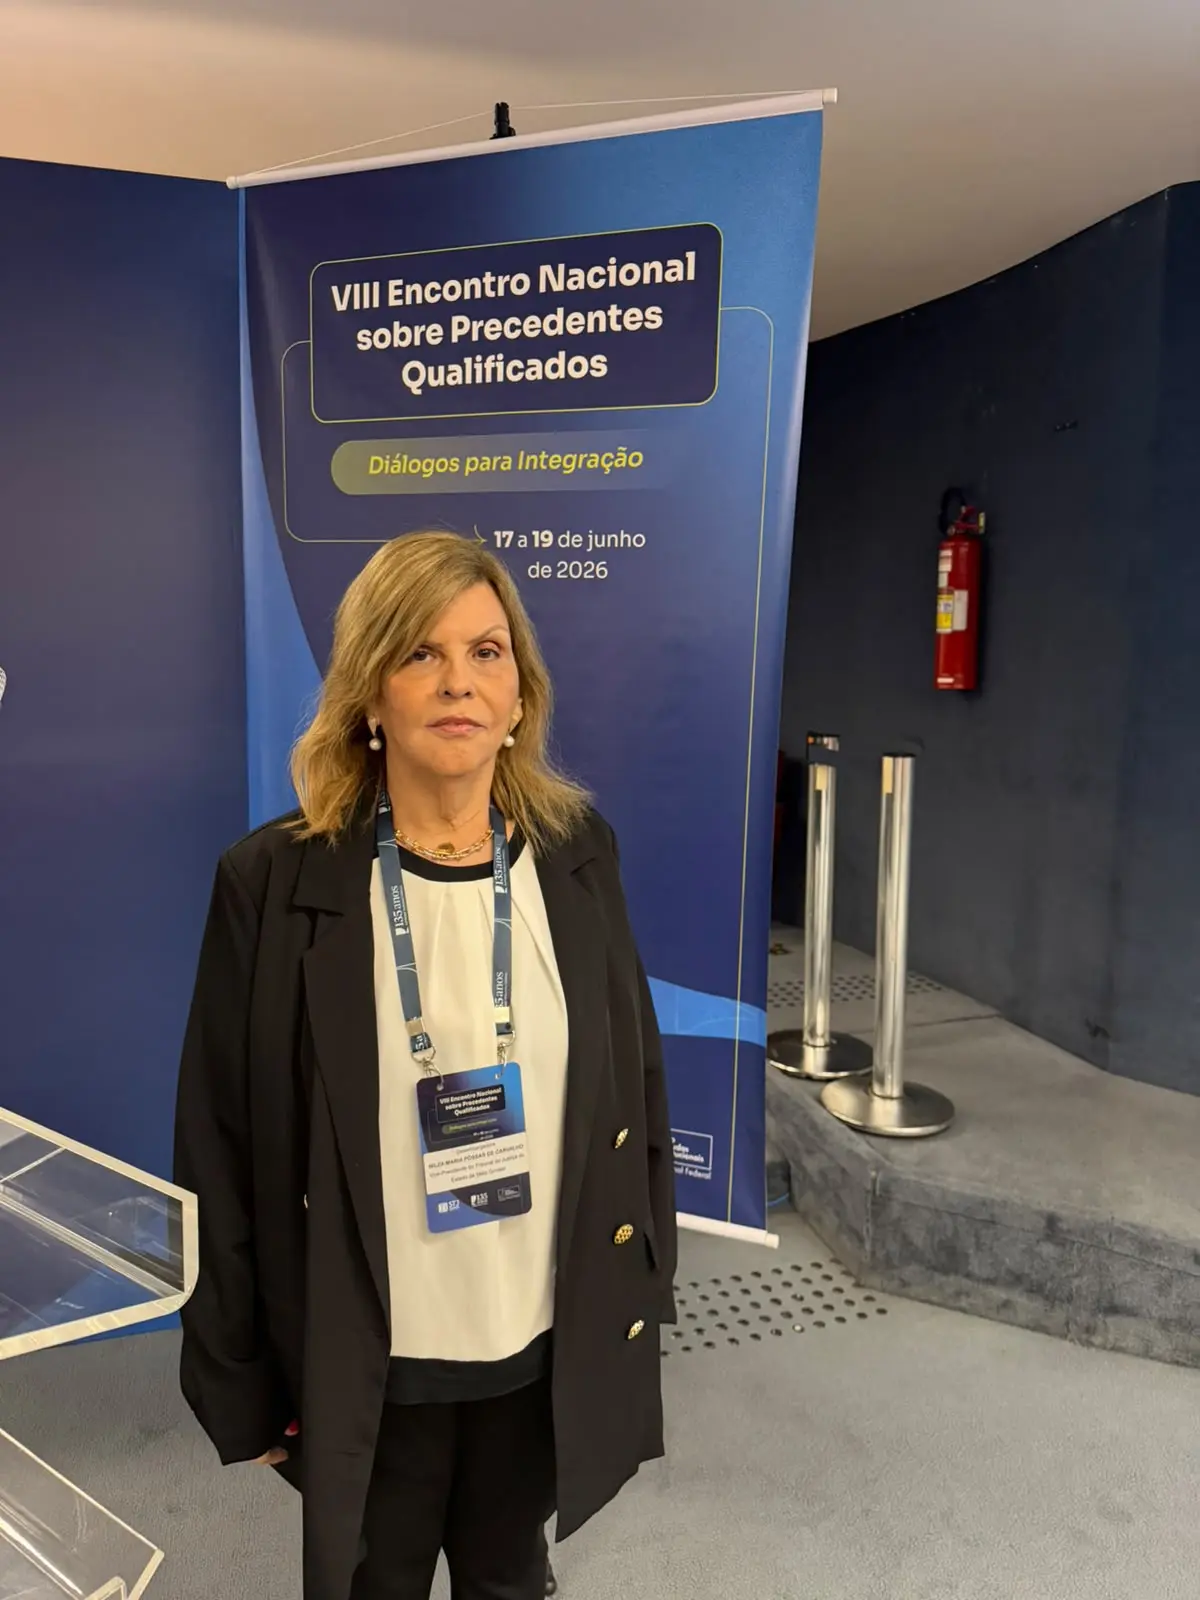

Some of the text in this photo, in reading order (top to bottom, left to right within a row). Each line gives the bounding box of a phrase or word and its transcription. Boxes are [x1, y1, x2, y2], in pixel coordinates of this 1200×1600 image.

[331, 251, 696, 311] VIII Encontro Nacional
[356, 305, 663, 351] sobre Precedentes
[401, 351, 608, 395] Qualificados
[368, 447, 644, 478] Diálogos para Integração
[494, 529, 646, 552] 17 a 19 de junho
[527, 560, 608, 579] de 2026
